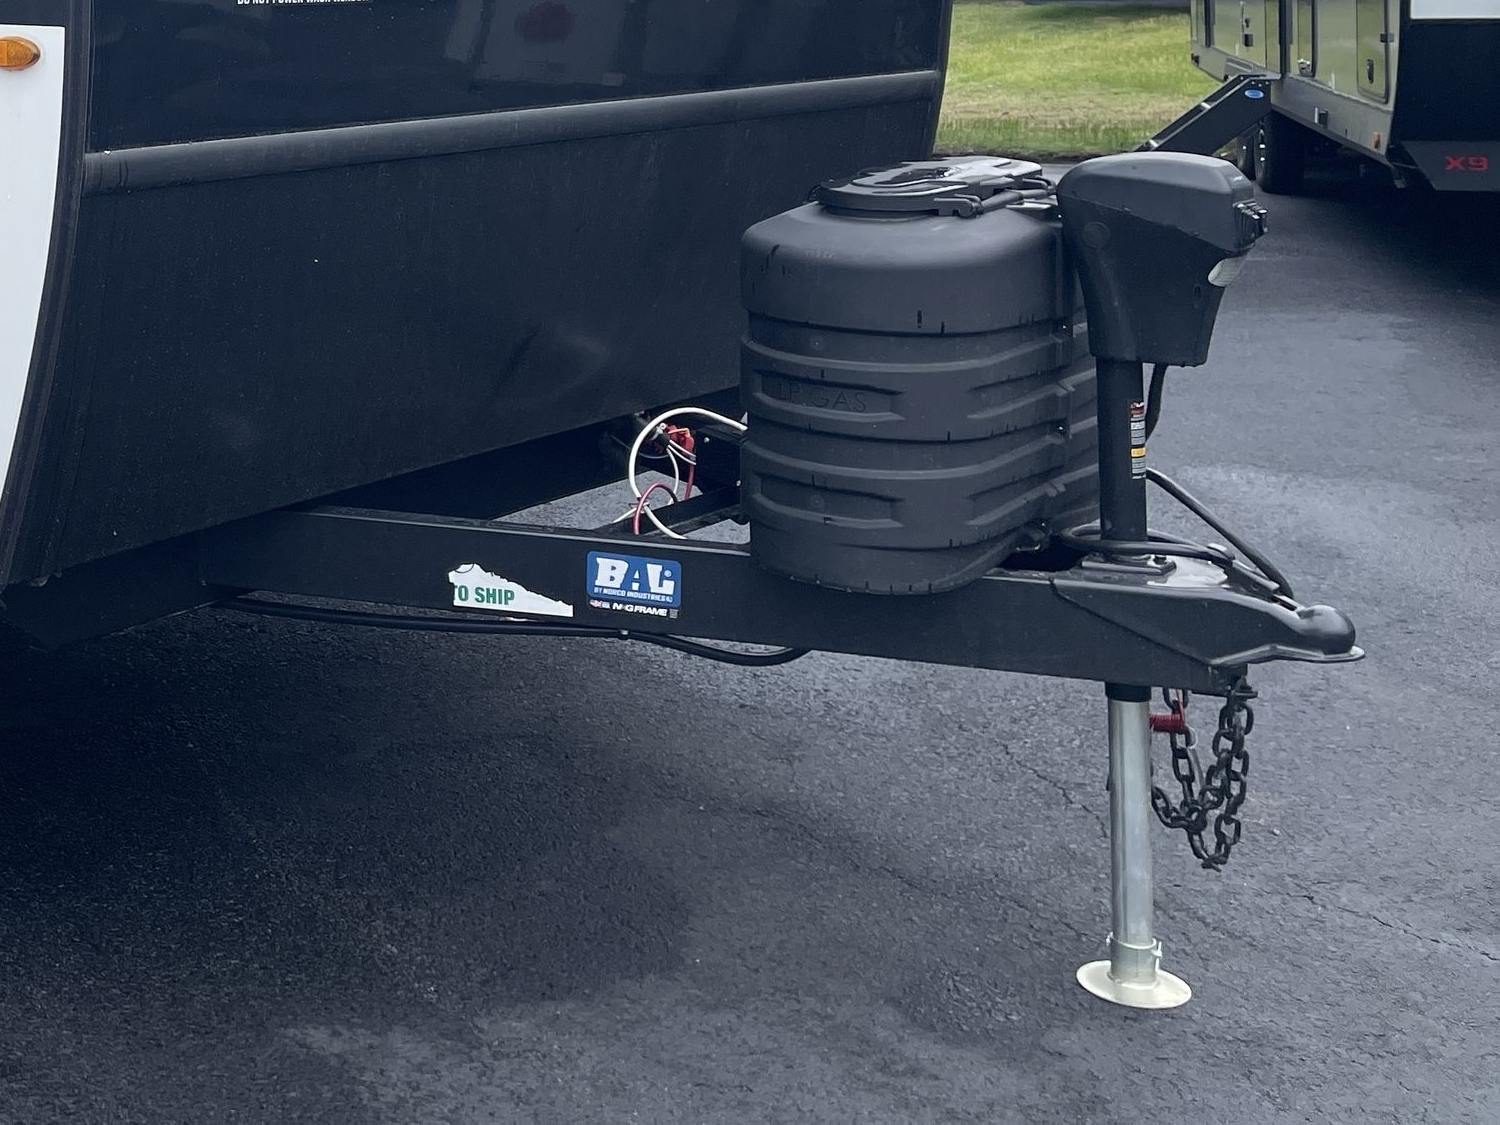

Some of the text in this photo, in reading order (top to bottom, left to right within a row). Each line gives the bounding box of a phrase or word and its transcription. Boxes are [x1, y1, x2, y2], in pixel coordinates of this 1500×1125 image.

[1444, 155, 1488, 172] X9
[810, 386, 867, 413] GAS
[595, 557, 675, 595] BAL
[474, 586, 515, 606] SHIP
[626, 590, 666, 602] INDUSTRIES
